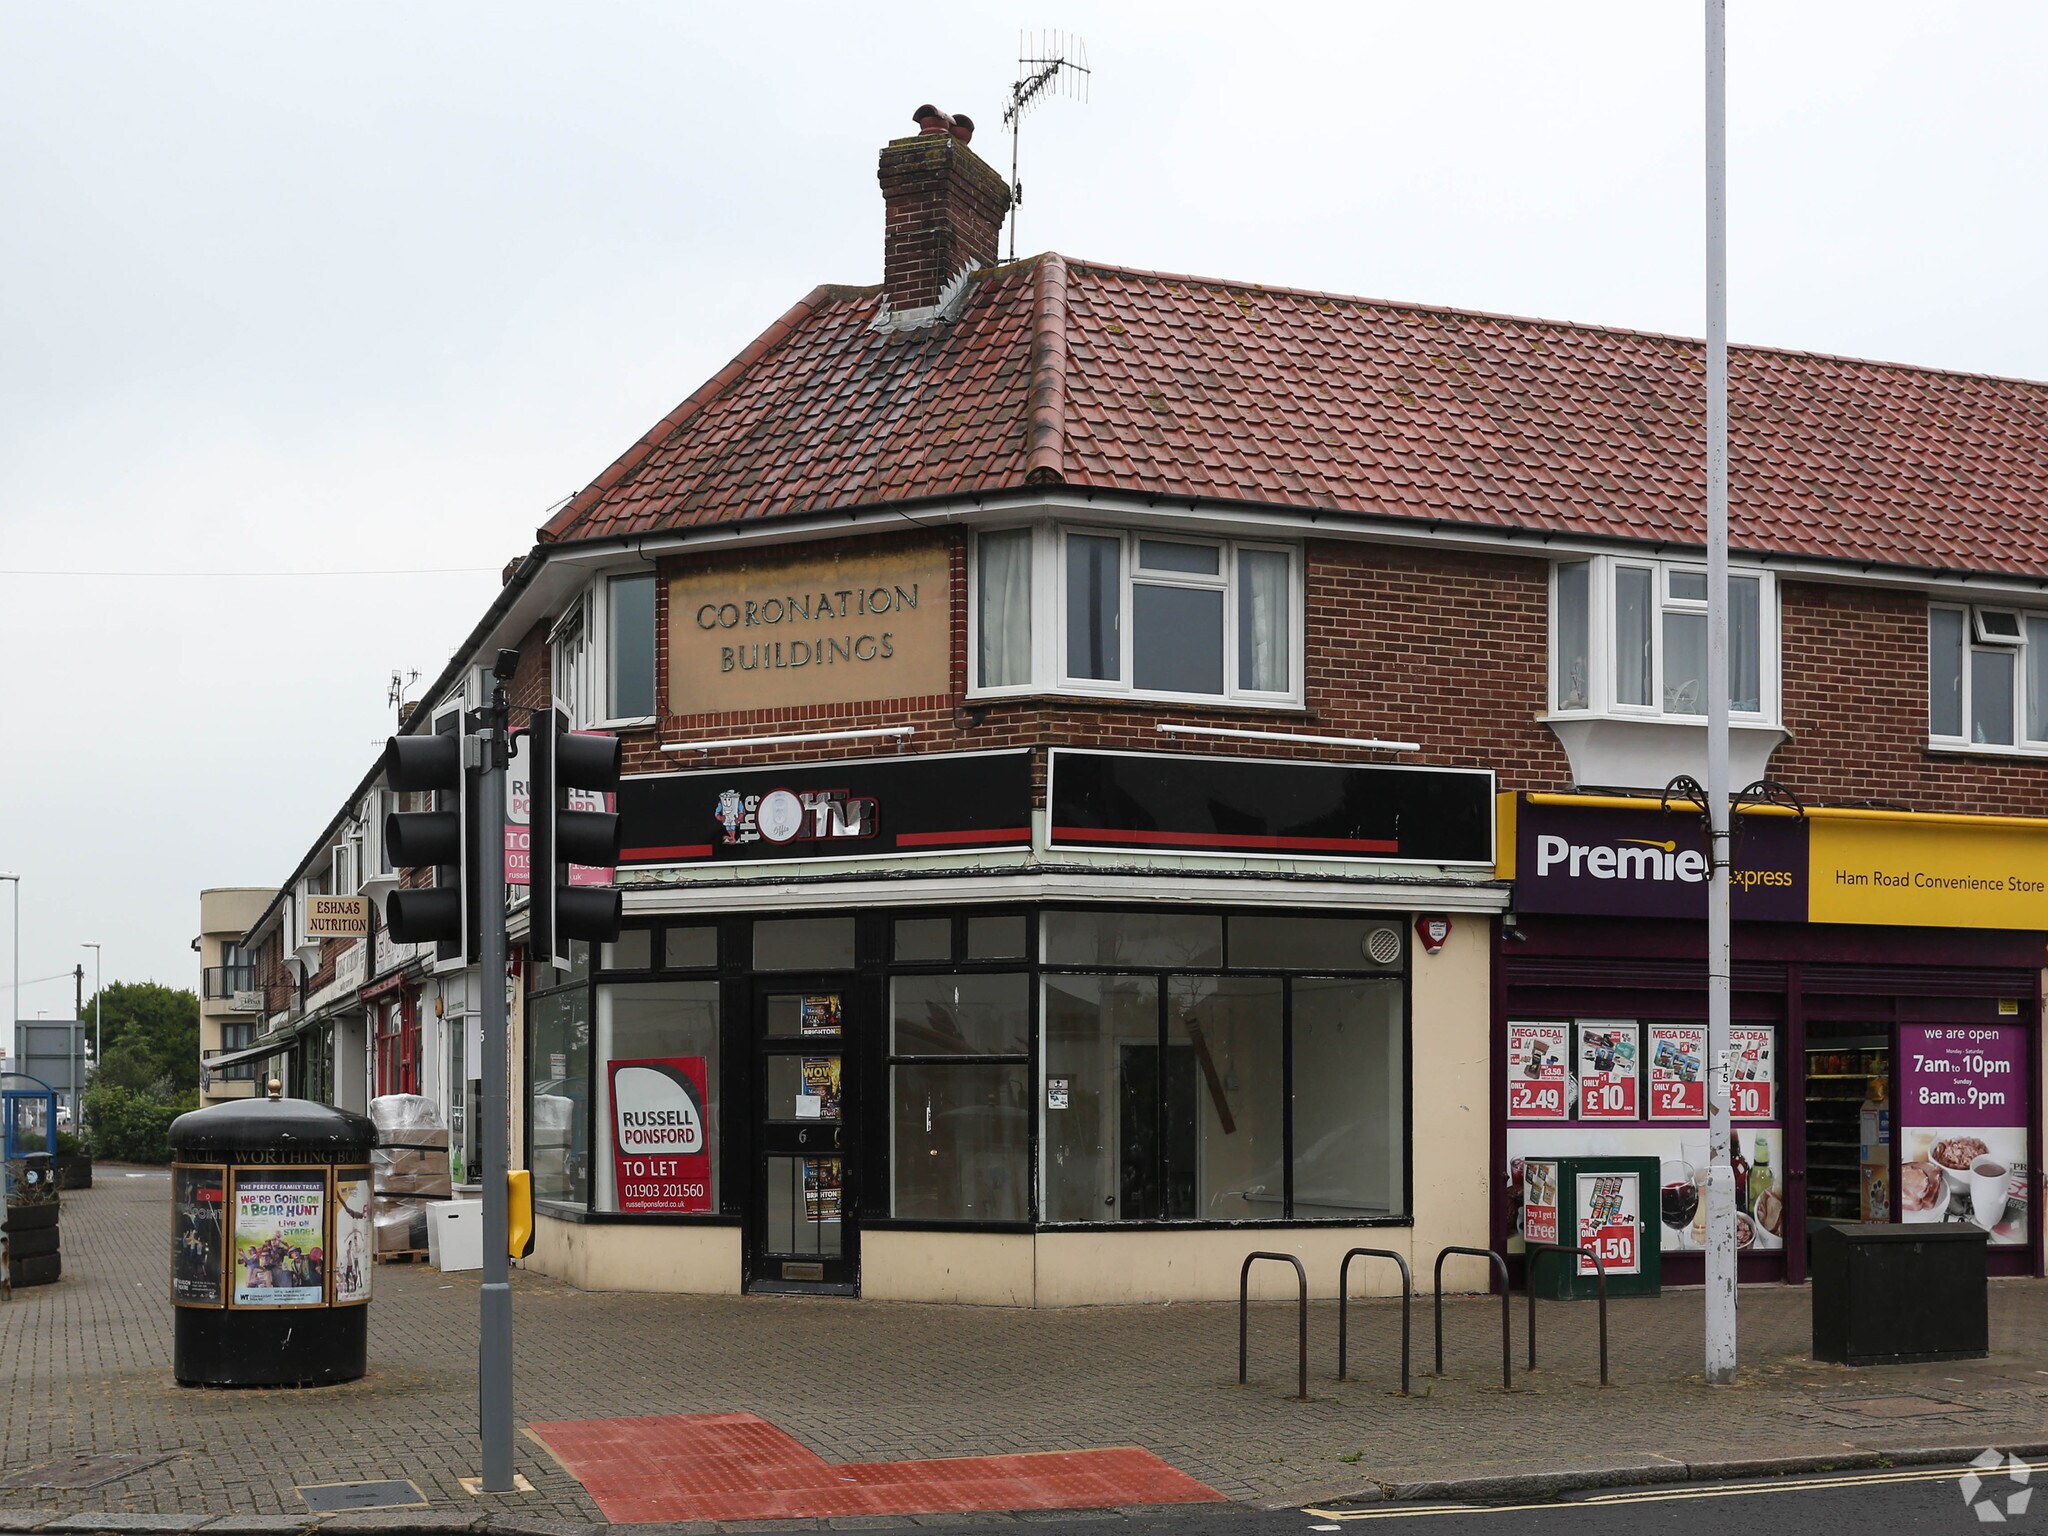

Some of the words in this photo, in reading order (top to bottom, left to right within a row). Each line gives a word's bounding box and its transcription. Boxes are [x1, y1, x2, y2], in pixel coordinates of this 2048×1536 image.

[696, 583, 918, 630] CORONATION
[721, 632, 894, 672] BUILDINGS
[1835, 869, 1869, 886] Ham
[1873, 871, 1910, 887] Road
[1914, 873, 2004, 891] Convenience
[2008, 876, 2045, 893] Store
[310, 918, 367, 932] NUTRITION
[1511, 1028, 1538, 1038] MEGA
[1540, 1029, 1563, 1038] DEAL
[1652, 1030, 1678, 1039] MEGA
[1679, 1031, 1702, 1039] DEAL
[1730, 1031, 1746, 1040] EGA
[1747, 1031, 1769, 1040] DEAL
[1924, 1029, 1942, 1039] we
[1946, 1029, 1965, 1039] are
[1968, 1029, 1999, 1043] open
[803, 1066, 833, 1079] WOW
[1912, 1054, 1950, 1073] 7am
[1951, 1064, 1961, 1073] to
[1962, 1055, 2011, 1078] 10pm
[1583, 1079, 1600, 1087] ONLY
[1722, 1073, 1729, 1083] 5
[1953, 1078, 1973, 1086] Sunday
[1653, 1083, 1670, 1091] ONLY
[1512, 1089, 1559, 1109] £2.49
[1587, 1085, 1625, 1110] £10
[1662, 1083, 1686, 1109] £2
[1919, 1086, 1956, 1105] 8am
[1957, 1096, 1966, 1105] to
[1967, 1087, 2005, 1110] 9pm
[622, 1110, 694, 1127] RUSSELL
[624, 1128, 695, 1145] PONSFORD
[799, 1128, 807, 1144] 6
[236, 1149, 333, 1164] WORTHING
[622, 1161, 645, 1177] TO
[650, 1161, 678, 1177] LET
[625, 1184, 660, 1198] 01903
[663, 1183, 704, 1198] 201560
[241, 1205, 248, 1216] A
[286, 1205, 319, 1218] HUNT
[626, 1200, 685, 1209] russellponsford.co.uk
[1527, 1209, 1539, 1219] buy
[1543, 1212, 1552, 1220] get
[1527, 1219, 1556, 1239] free
[1581, 1229, 1598, 1238] ONLY
